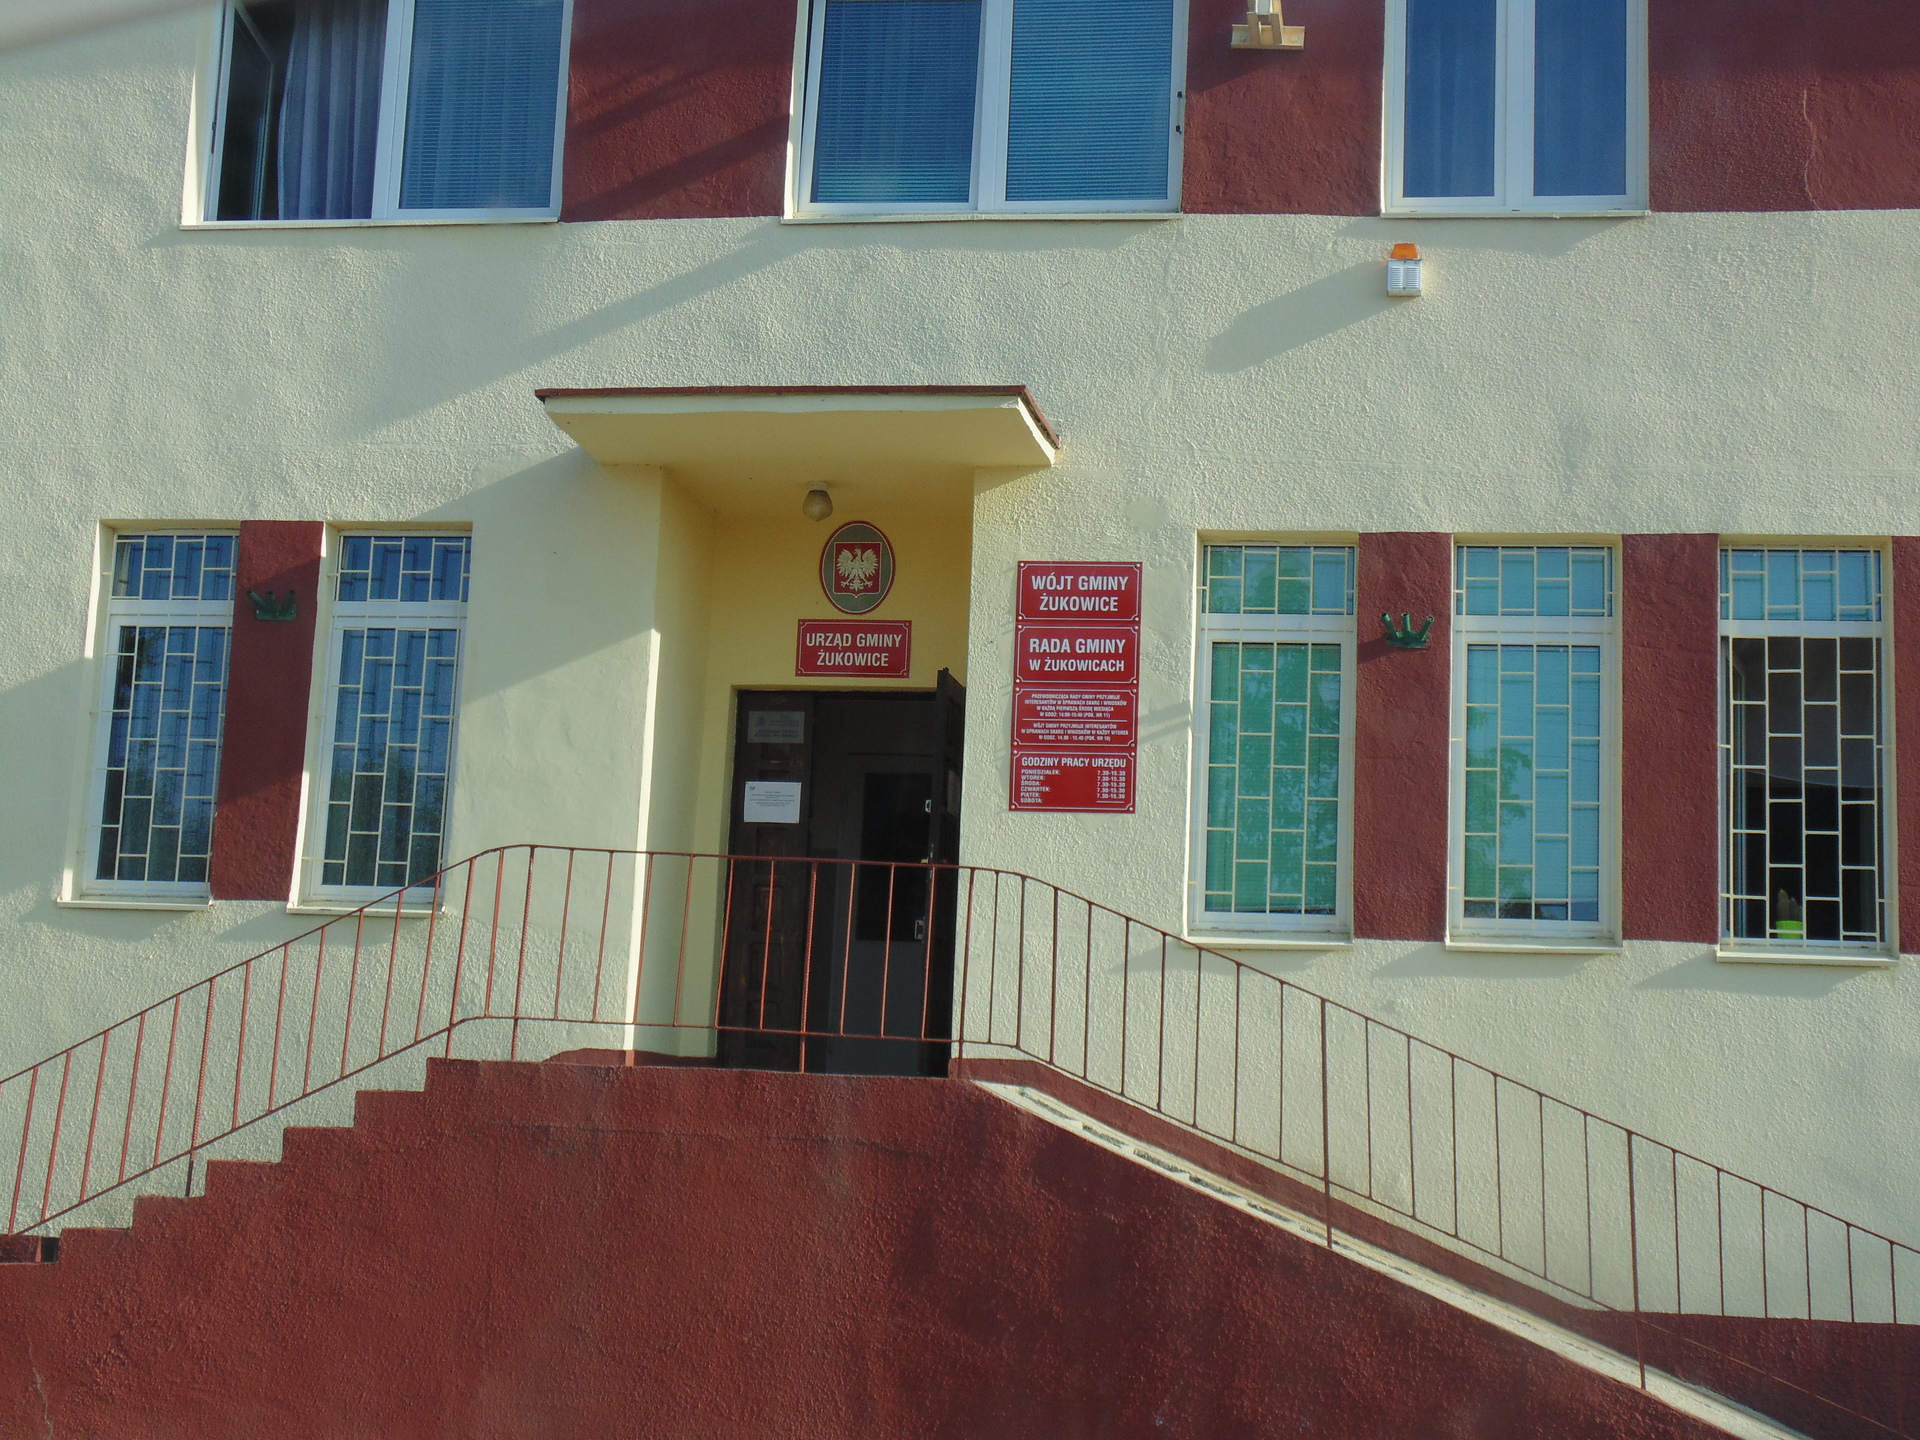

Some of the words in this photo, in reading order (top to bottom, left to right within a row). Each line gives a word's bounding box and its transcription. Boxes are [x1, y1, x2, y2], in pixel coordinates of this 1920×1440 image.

[1031, 572, 1074, 590] WÓJT
[1078, 576, 1128, 590] GMINY
[1040, 592, 1118, 611] ŻUKOWICE
[806, 633, 852, 650] URZĄD
[856, 634, 902, 648] GMINY
[1029, 638, 1070, 653] RADA
[1075, 638, 1126, 654] GMINY
[817, 649, 888, 666] ŻUKOWICE
[1029, 660, 1040, 671] W
[1044, 656, 1124, 672] ŻUKOWICACH
[1022, 757, 1059, 766] GODZINY
[1062, 758, 1089, 767] PRACY
[1092, 758, 1126, 769] URZĘDU
